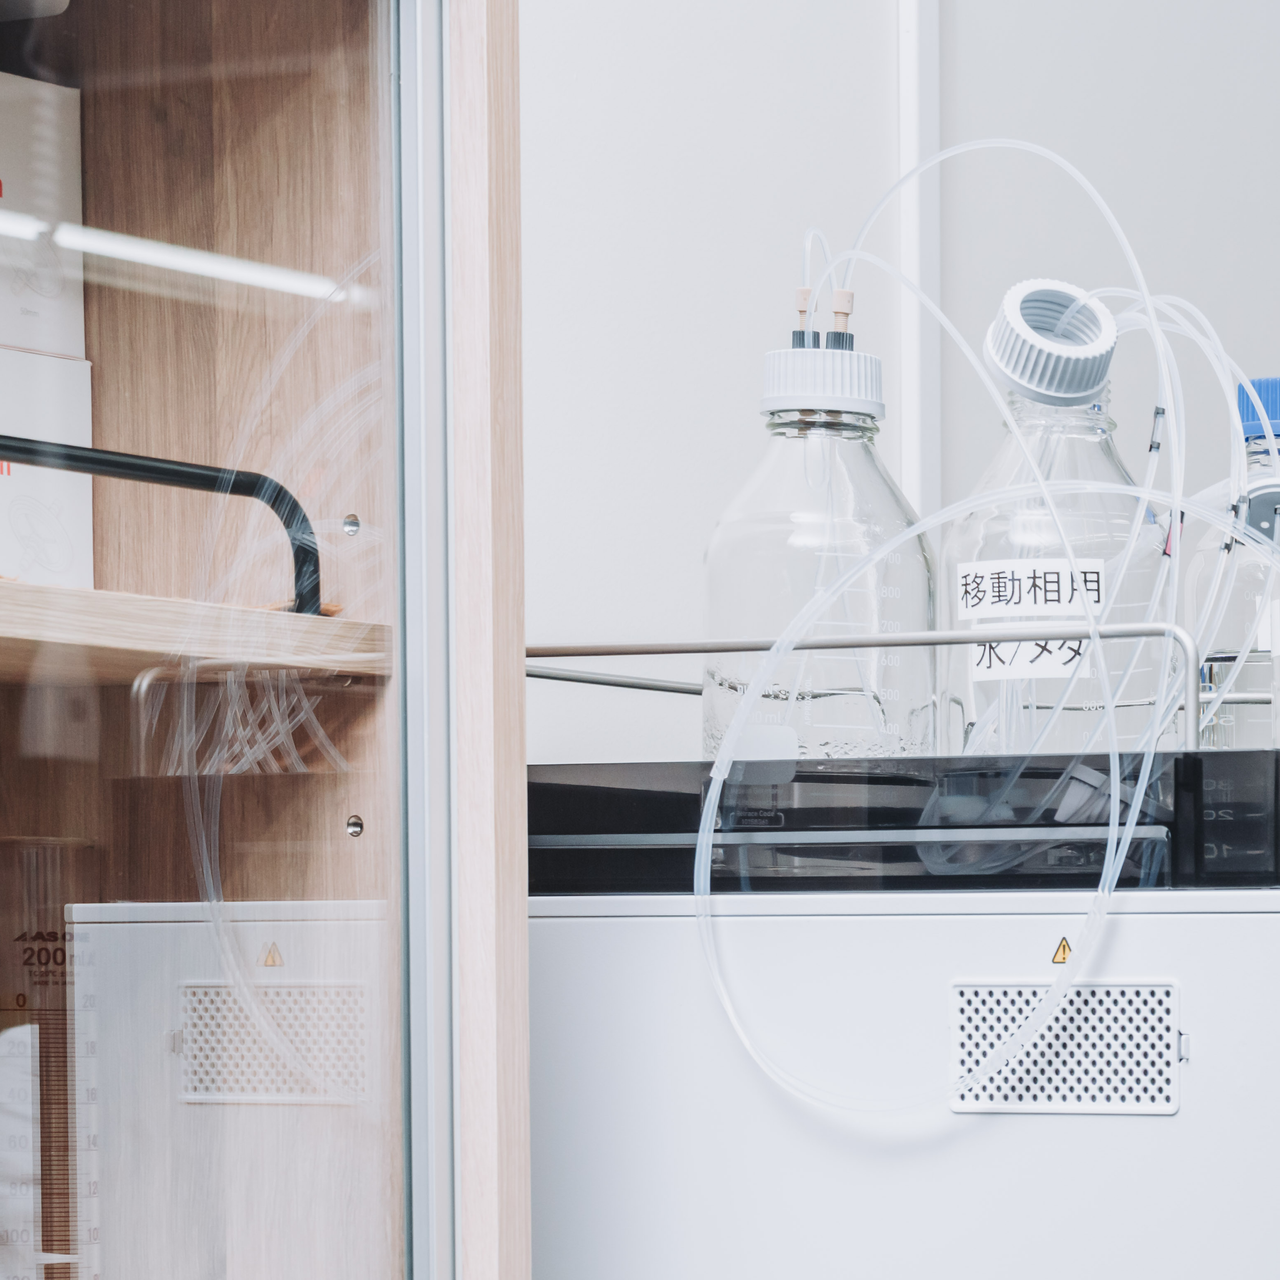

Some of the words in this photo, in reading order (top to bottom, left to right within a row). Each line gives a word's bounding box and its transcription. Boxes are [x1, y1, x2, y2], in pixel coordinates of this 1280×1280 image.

[961, 569, 1101, 609] 移動相用
[881, 655, 899, 666] 600
[881, 689, 899, 700] 500
[23, 947, 66, 966] 200
[83, 993, 97, 1009] 20
[85, 1040, 98, 1055] 18
[86, 1087, 98, 1101] 16
[88, 1180, 99, 1195] 12
[88, 1227, 100, 1242] 10
